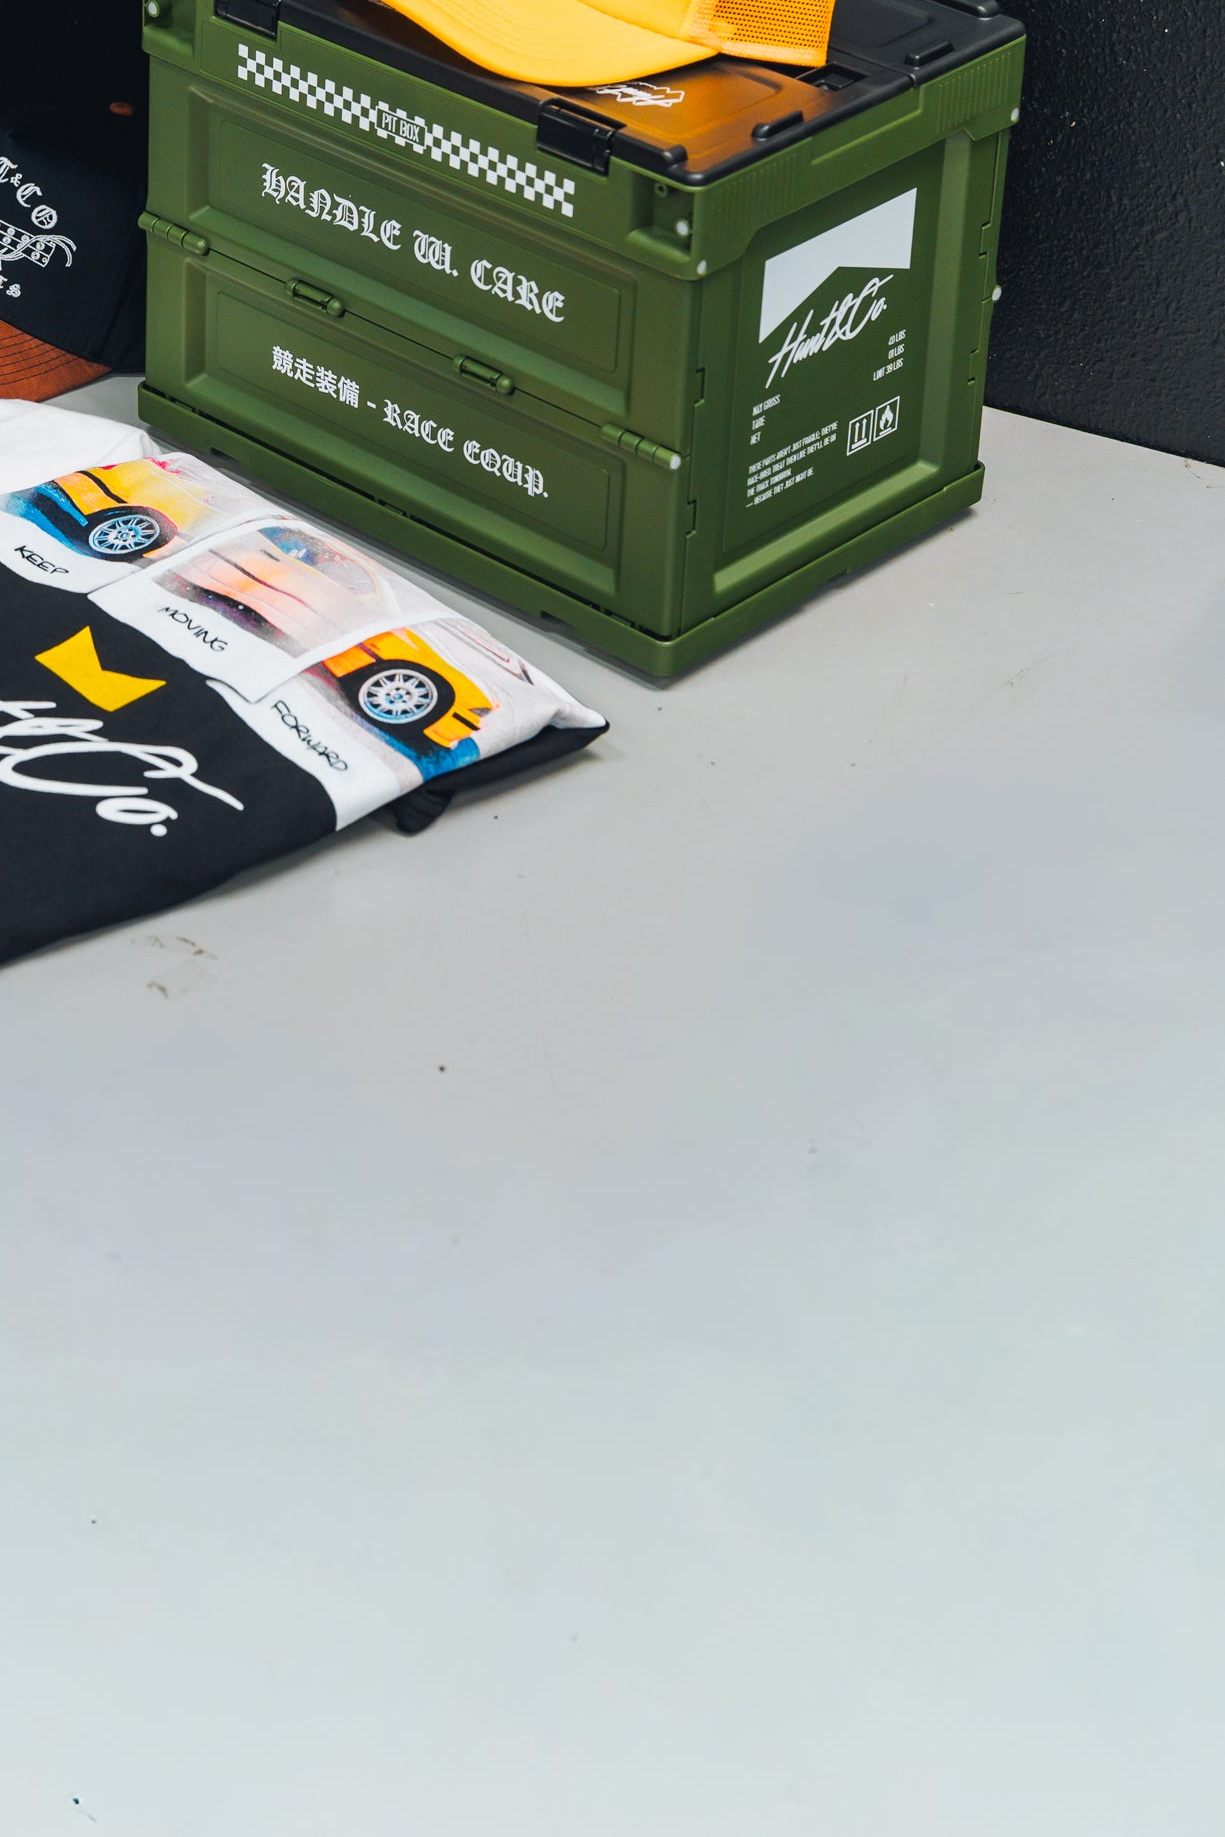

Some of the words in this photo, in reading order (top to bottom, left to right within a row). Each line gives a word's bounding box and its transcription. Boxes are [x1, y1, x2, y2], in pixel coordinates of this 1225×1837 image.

[382, 112, 397, 132] PIT
[400, 120, 420, 143] BOX
[261, 163, 401, 250] HANDLE
[413, 230, 459, 276] W.
[470, 259, 565, 323] CARE
[272, 345, 360, 409] 競走装備
[383, 399, 455, 452] RACE
[463, 440, 549, 498] EQUP.
[14, 545, 69, 575] KEEP
[157, 606, 228, 652] MOVING
[270, 700, 349, 773] FORWARD
